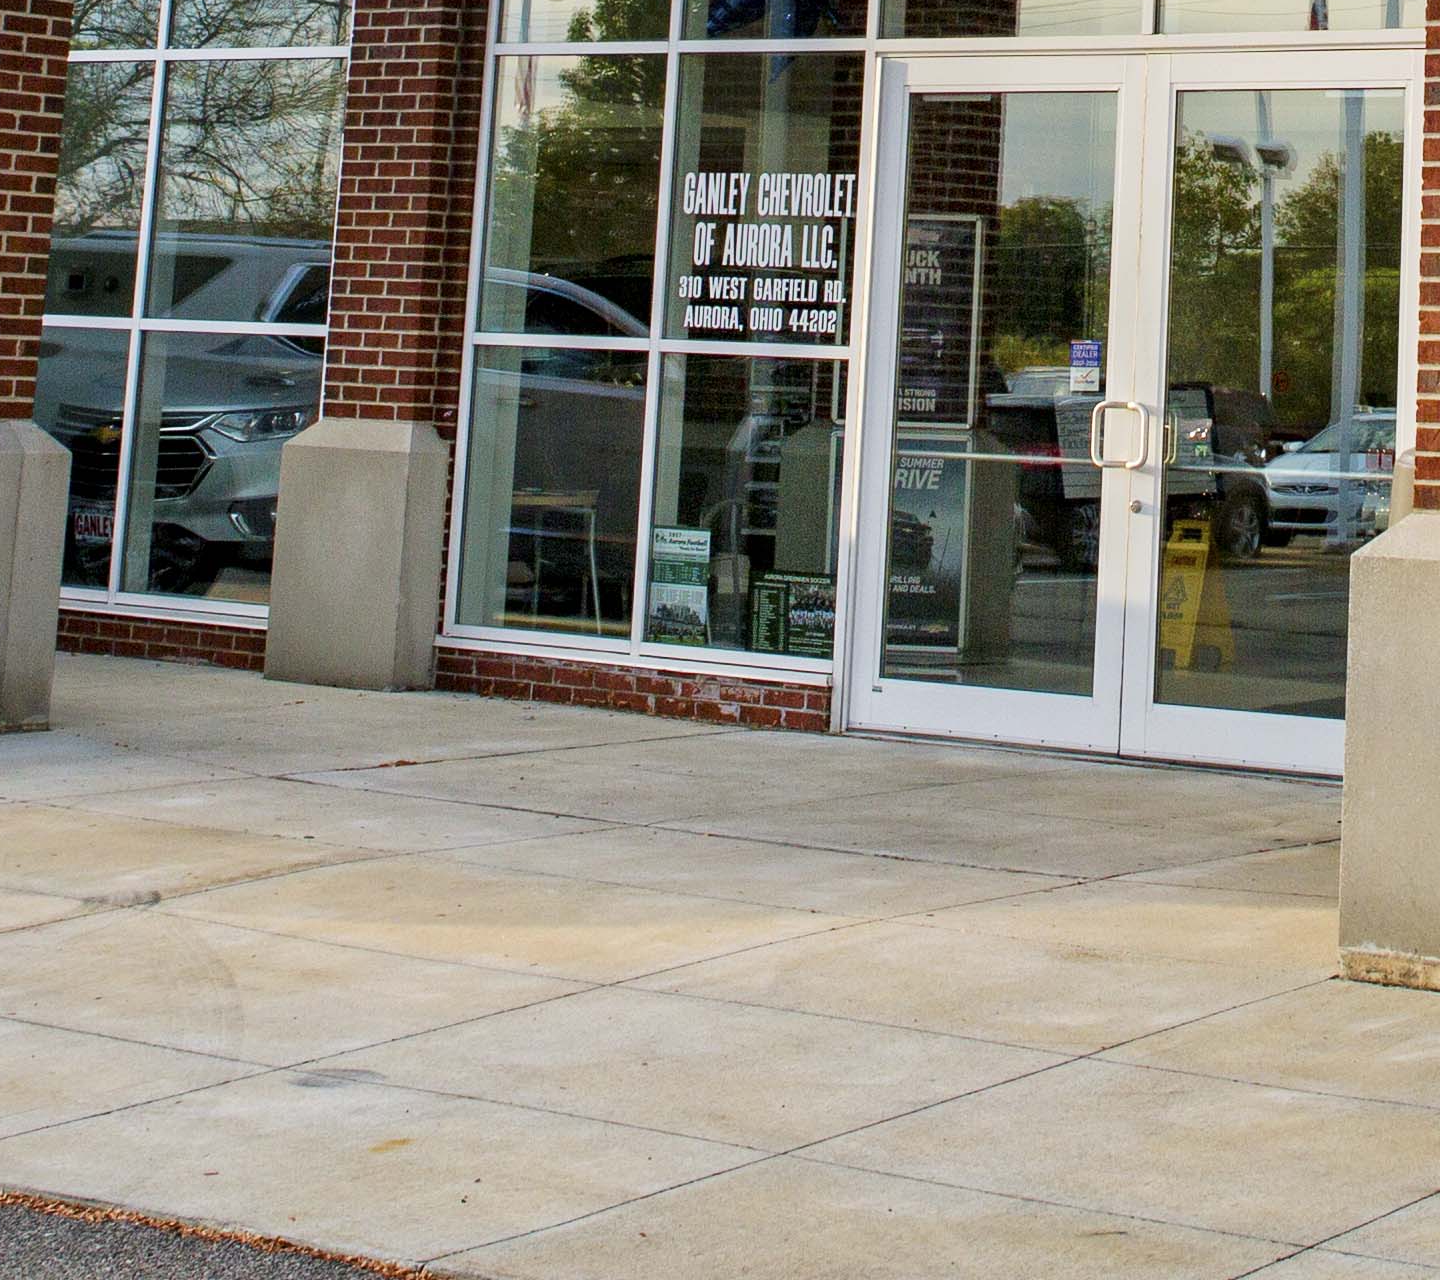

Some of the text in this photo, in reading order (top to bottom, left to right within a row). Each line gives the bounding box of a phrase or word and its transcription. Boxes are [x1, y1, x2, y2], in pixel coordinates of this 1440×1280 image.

[683, 172, 856, 218] GANLEY CHEVROLET
[693, 222, 838, 269] OF AURORA LLC.
[905, 250, 941, 267] UCK
[904, 267, 942, 285] NTH
[678, 275, 847, 304] 310 WEST GARFIELD RD.
[684, 305, 837, 333] AURORA, OHIO 44202
[898, 397, 936, 412] ISION
[900, 456, 945, 469] SUMMER
[895, 469, 942, 490] RIVE
[75, 514, 112, 537] GANLE
